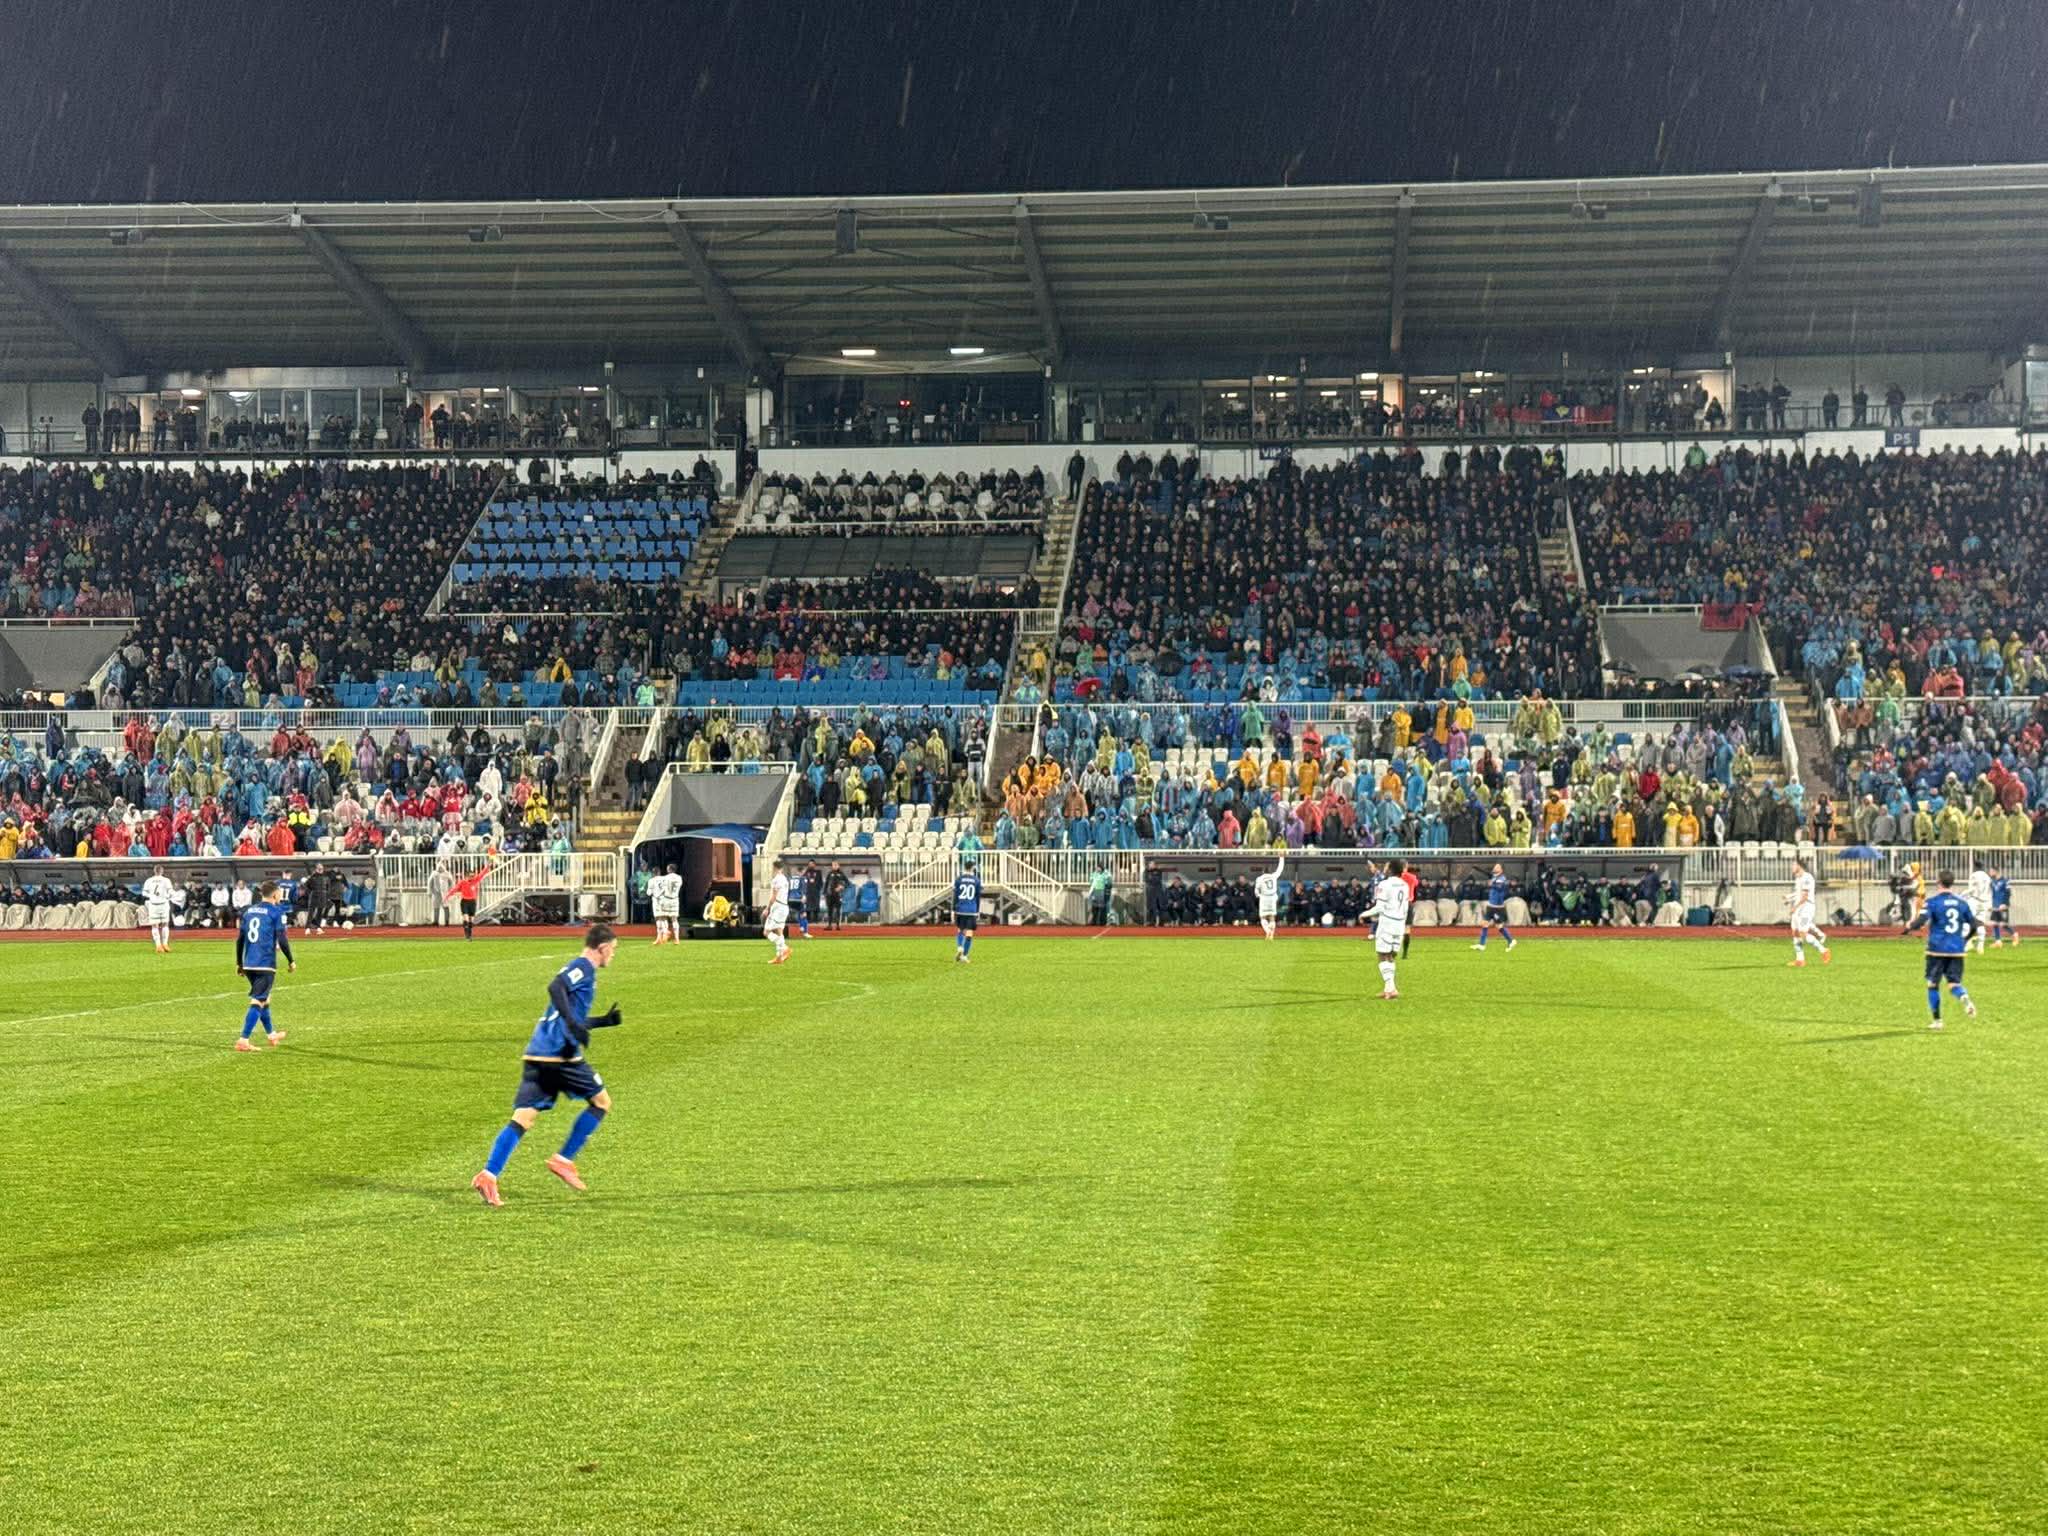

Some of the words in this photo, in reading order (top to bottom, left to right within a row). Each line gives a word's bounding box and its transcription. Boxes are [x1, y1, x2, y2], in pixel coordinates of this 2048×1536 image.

[279, 887, 290, 901] 11
[958, 884, 975, 900] 20
[247, 917, 260, 943] 8
[1944, 908, 1959, 934] 3
